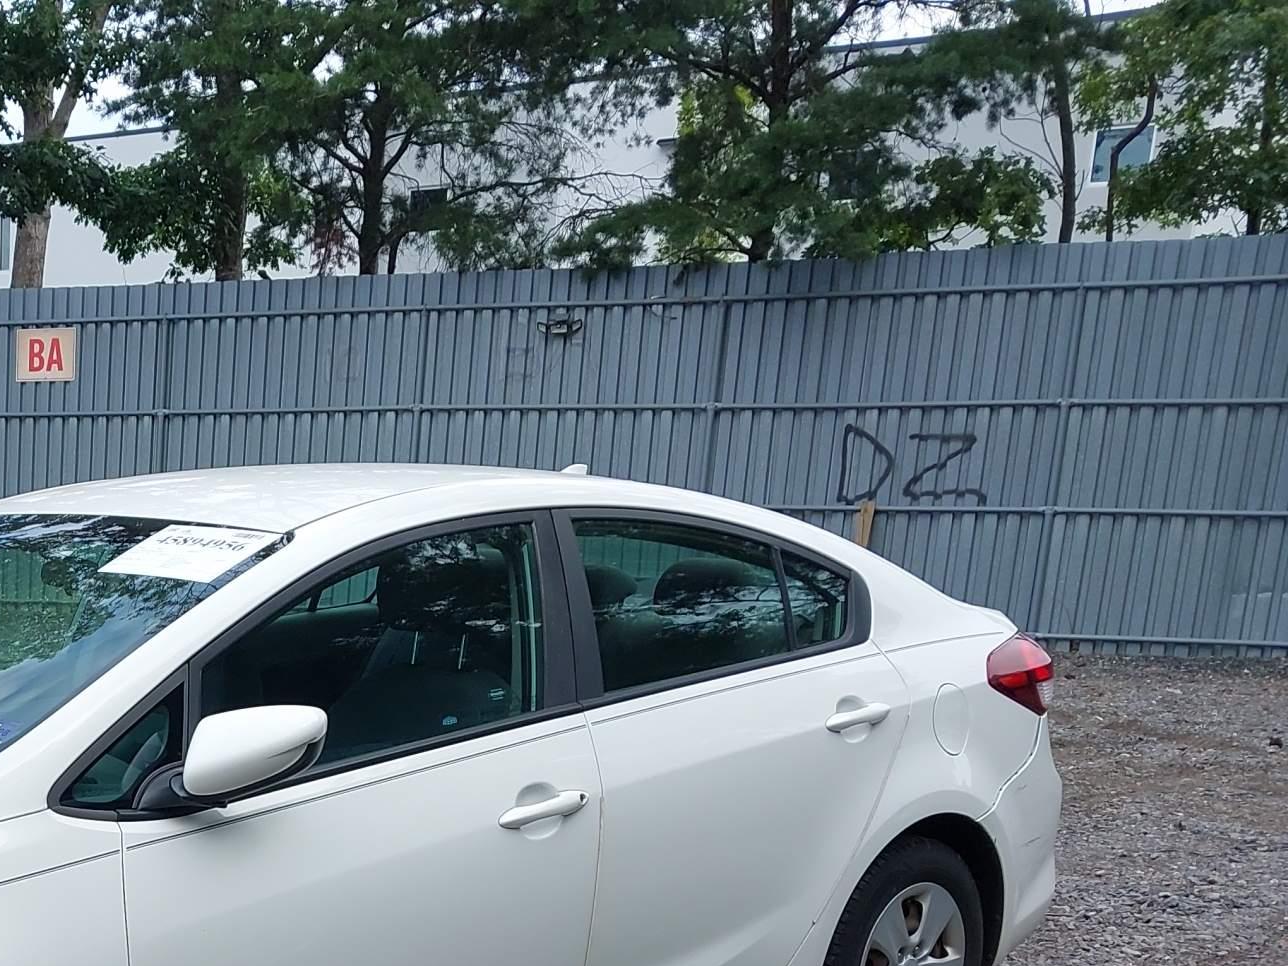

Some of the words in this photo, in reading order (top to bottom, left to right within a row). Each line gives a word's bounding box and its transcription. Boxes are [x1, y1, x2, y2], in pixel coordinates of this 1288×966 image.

[28, 338, 64, 372] BA
[836, 423, 987, 505] DZ
[157, 535, 246, 552] 45894956
